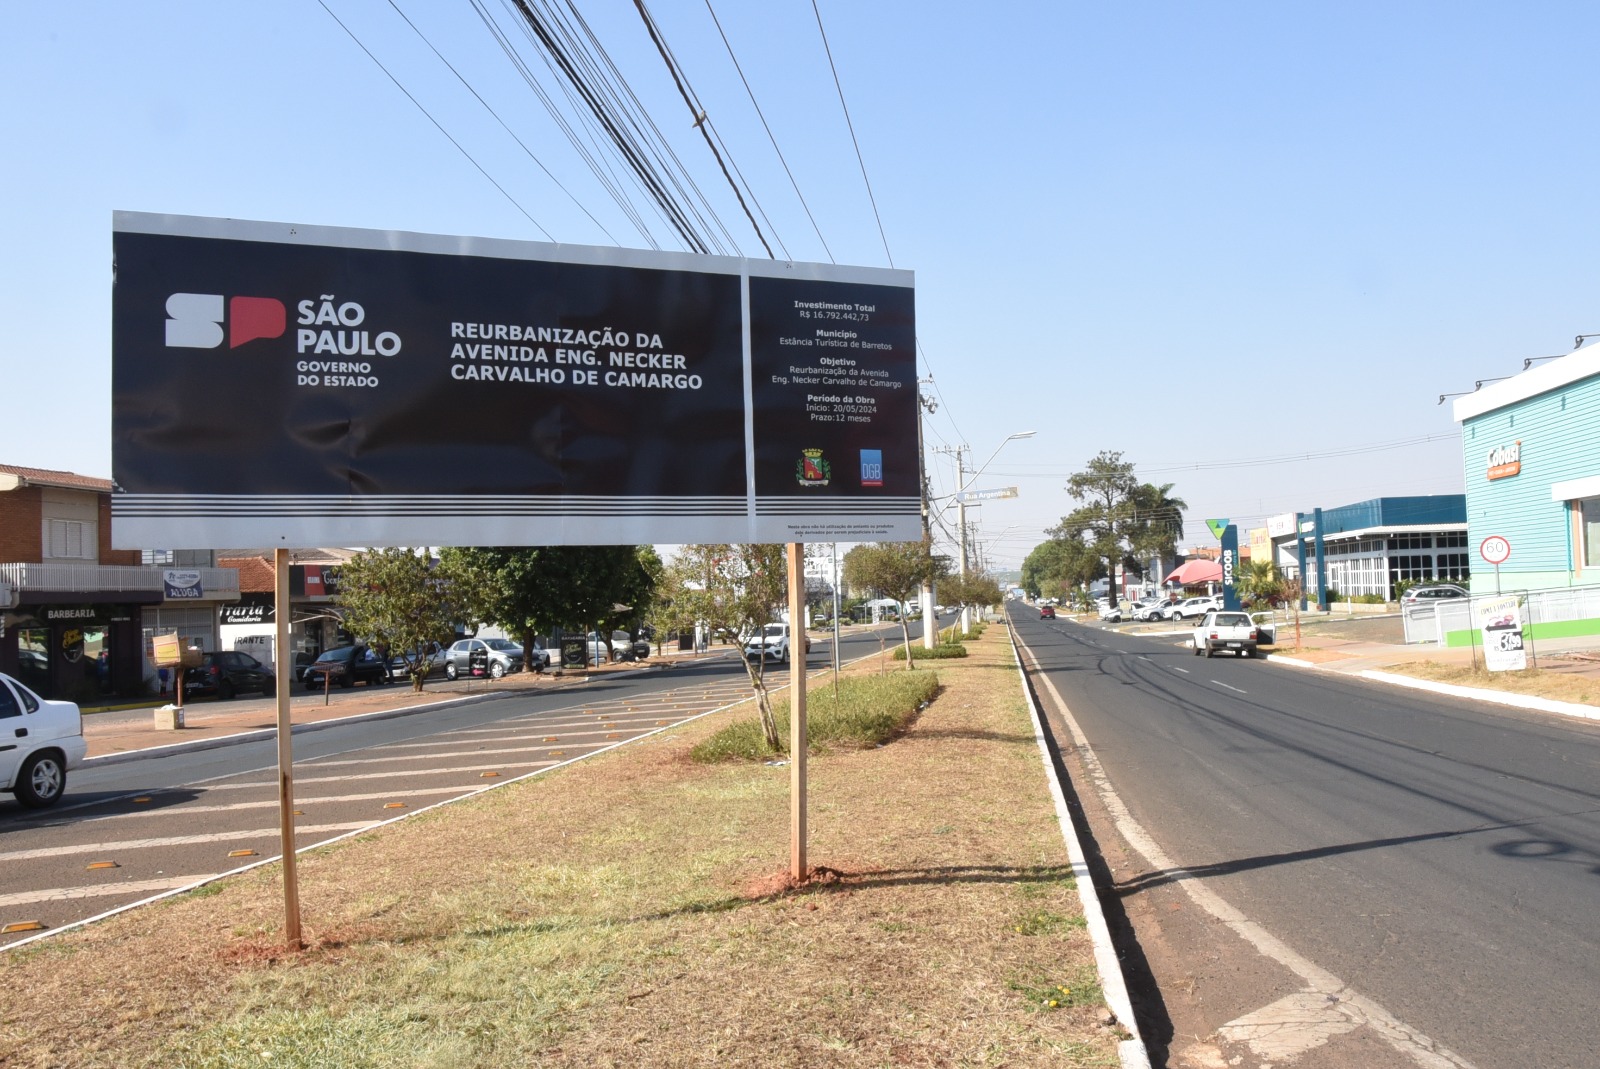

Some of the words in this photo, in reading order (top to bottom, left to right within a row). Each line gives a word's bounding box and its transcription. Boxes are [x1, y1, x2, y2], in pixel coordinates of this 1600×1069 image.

[297, 294, 365, 327] SÃO
[794, 300, 853, 311] Investimento
[854, 304, 876, 312] Total
[799, 310, 811, 319] R$
[813, 311, 870, 321] 16.792.442,73
[450, 322, 630, 349] REURBANIZAÇÃO
[635, 333, 663, 349] DA
[816, 329, 858, 340] Município
[297, 329, 402, 357] PAULO
[779, 337, 813, 346] Estância
[850, 340, 860, 348] de
[861, 341, 893, 351] Barretos
[450, 343, 548, 363] AVENIDA
[555, 349, 602, 366] ENG.
[609, 352, 687, 370] NECKER
[820, 357, 856, 367] Objetivo
[296, 361, 371, 374] GOVERNO
[789, 366, 847, 376] Reurbanização
[848, 367, 859, 376] da
[860, 368, 889, 378] Avenida
[297, 375, 319, 387] DO
[324, 375, 379, 388] ESTADO
[450, 364, 566, 384] CARVALHO
[572, 370, 599, 386] DE
[604, 371, 703, 390] CAMARGO
[772, 375, 790, 385] Eng.
[792, 376, 820, 385] Necker
[822, 376, 857, 386] Carvalho
[858, 378, 868, 386] de
[869, 378, 902, 390] Camargo
[842, 395, 853, 403] da
[855, 395, 876, 404] Obra
[833, 404, 877, 414] 20/05/2024
[847, 415, 871, 423] meses
[1488, 440, 1521, 468] Cobasi
[862, 463, 881, 479] DGB
[978, 490, 1011, 499] Argentina
[1486, 541, 1504, 553] 60
[1223, 549, 1233, 586] SICOOB
[170, 588, 199, 597] ALUGA
[48, 609, 96, 619] BARBEARIA
[227, 615, 262, 623] Comidaria
